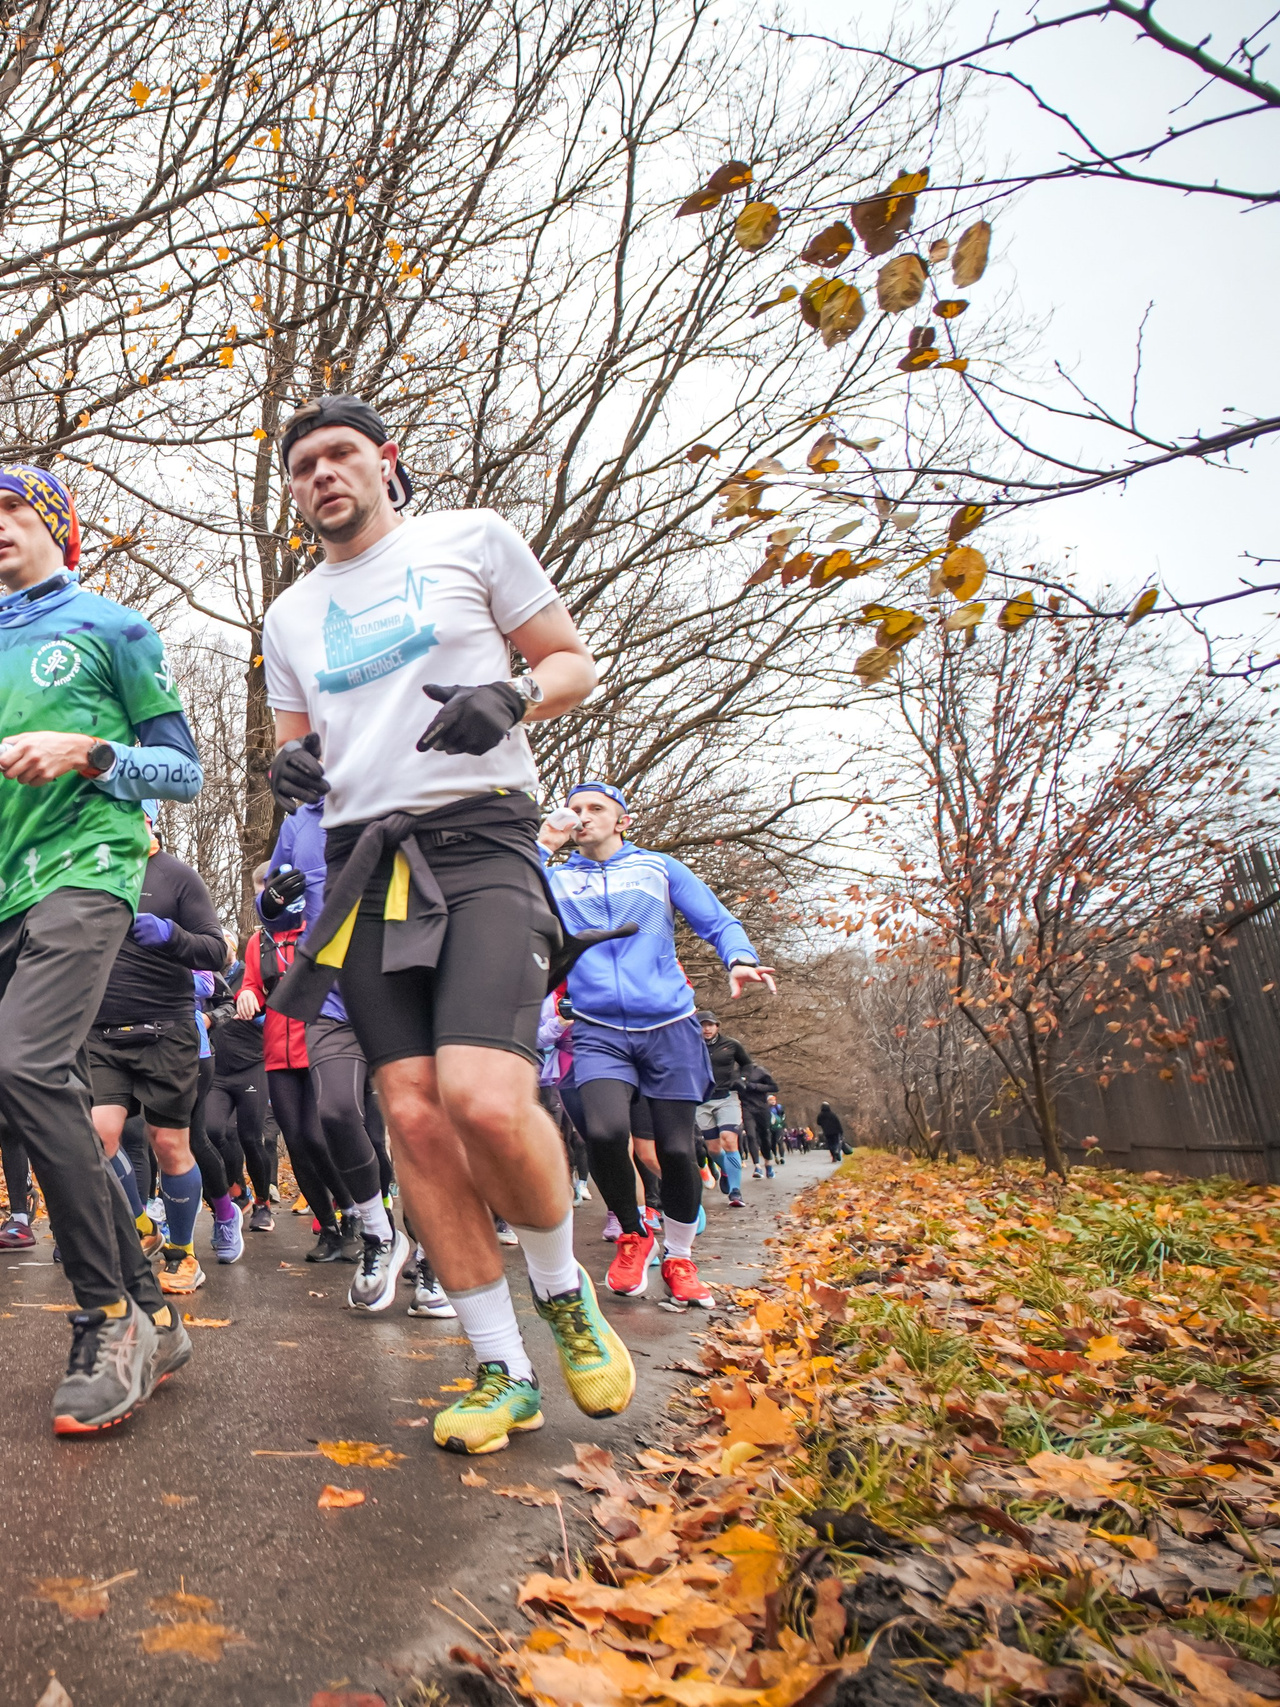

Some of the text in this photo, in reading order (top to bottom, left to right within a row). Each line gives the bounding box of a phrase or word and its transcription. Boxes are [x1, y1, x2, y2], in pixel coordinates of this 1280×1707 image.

[354, 614, 402, 637] КОЛОМНА
[346, 648, 405, 686] НА ПУЛЬСЕ
